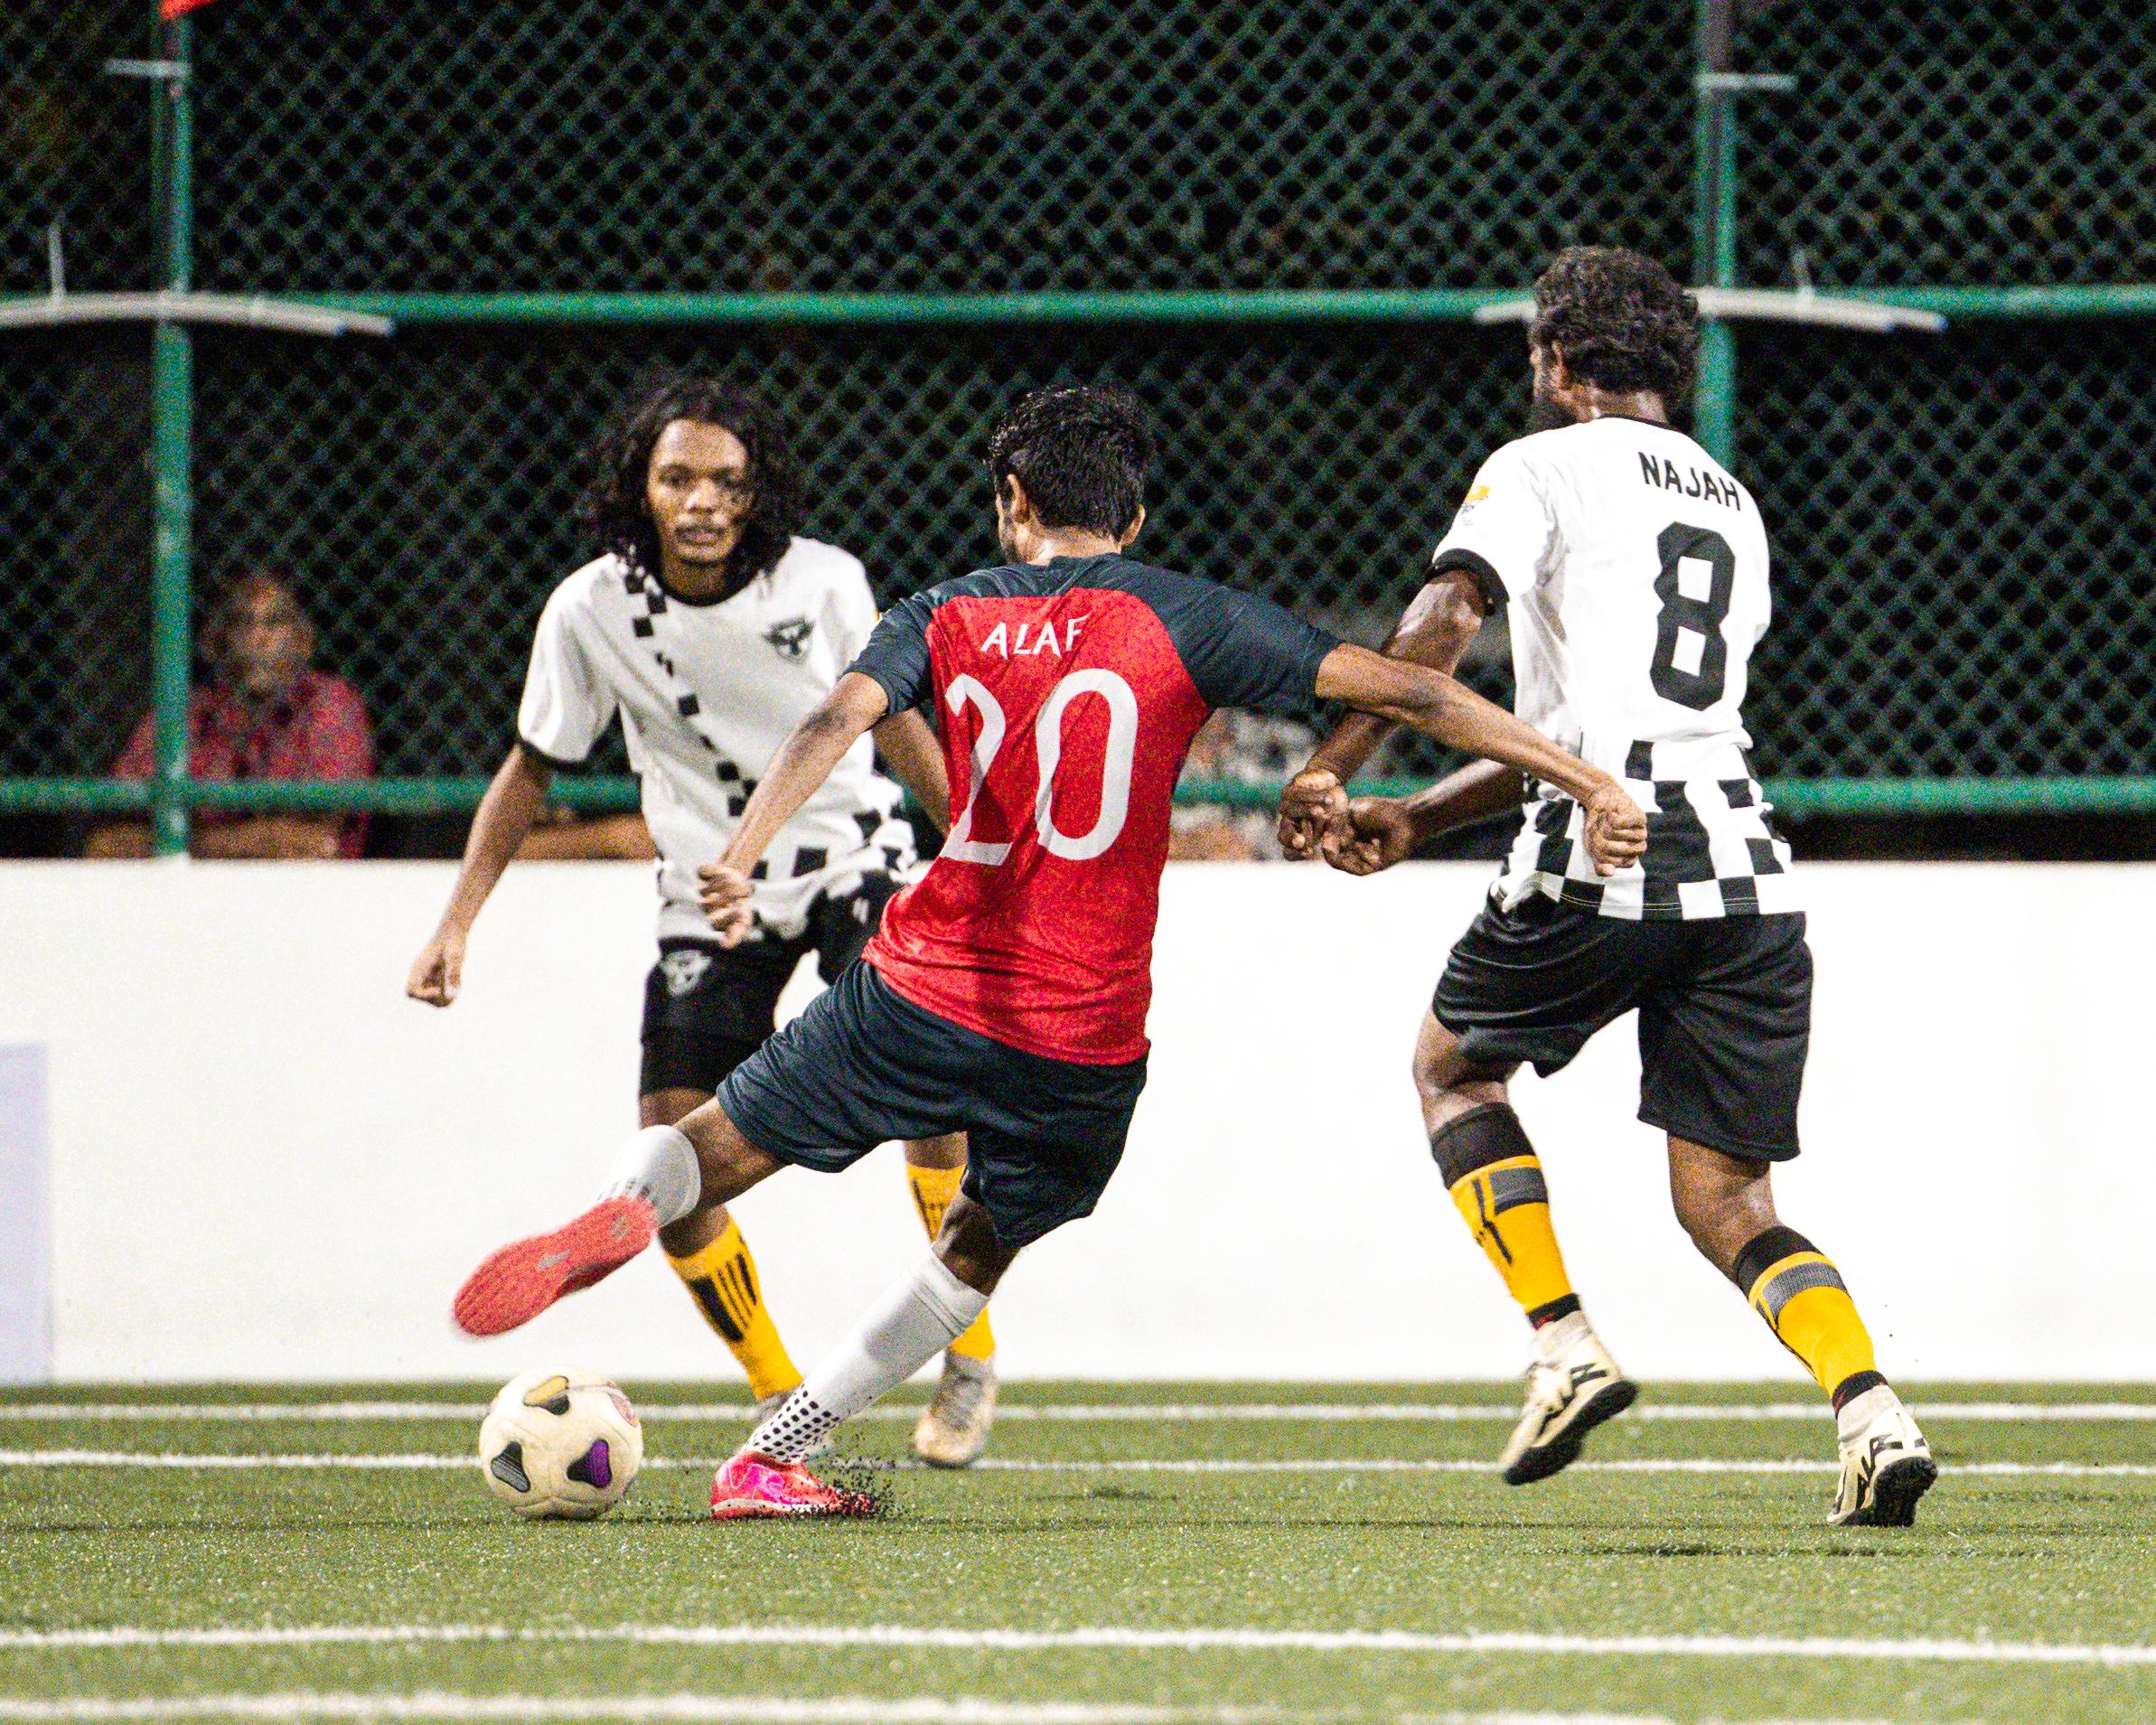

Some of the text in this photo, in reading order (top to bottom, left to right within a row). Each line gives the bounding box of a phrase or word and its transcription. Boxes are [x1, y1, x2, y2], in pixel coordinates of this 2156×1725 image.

[1638, 452, 1742, 511] NAJAH
[980, 610, 1093, 660] ALAF
[1649, 520, 1736, 712] 8
[939, 668, 1139, 867] 20
